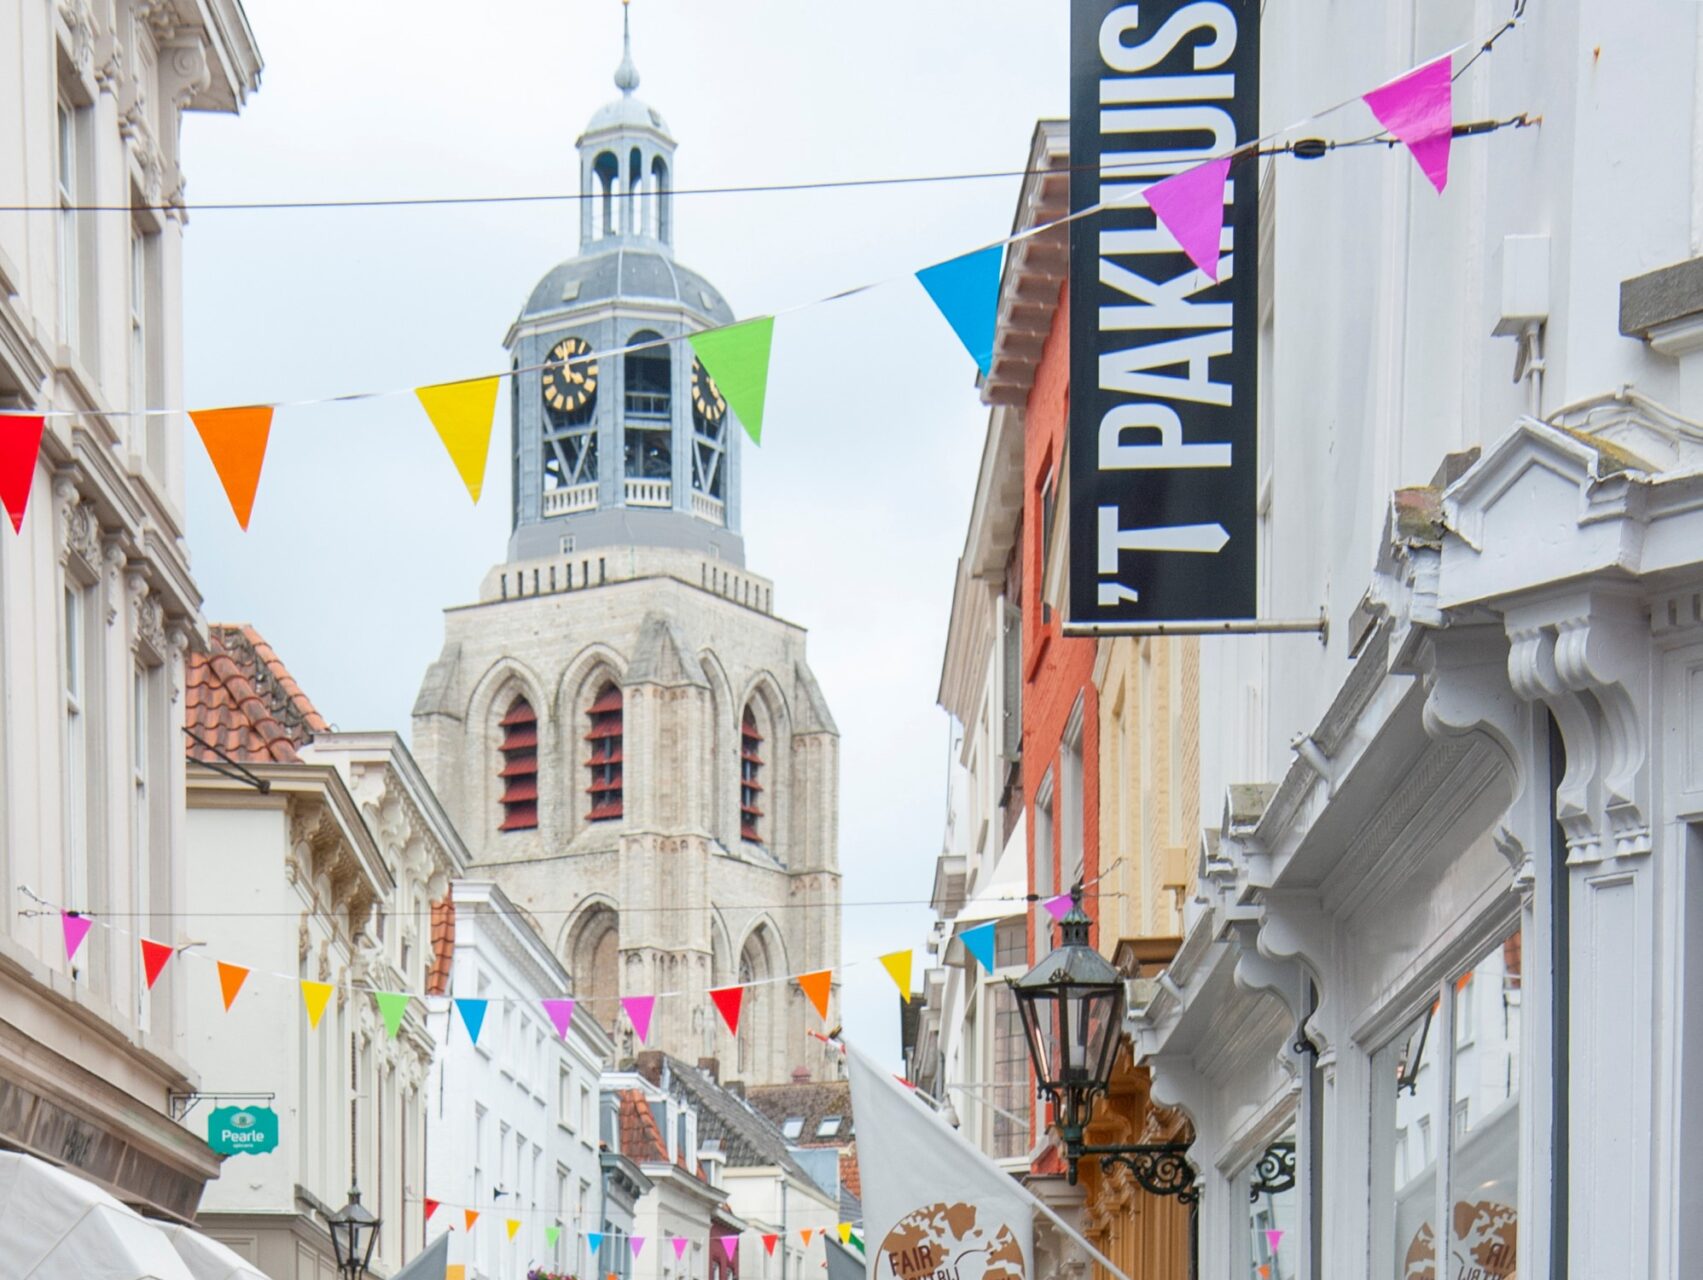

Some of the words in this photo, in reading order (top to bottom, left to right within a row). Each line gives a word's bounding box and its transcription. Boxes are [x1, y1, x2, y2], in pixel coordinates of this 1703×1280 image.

[1098, 1, 1238, 471] PAKHUIS
[222, 1129, 265, 1142] Pearle
[889, 1245, 934, 1277] FAIR
